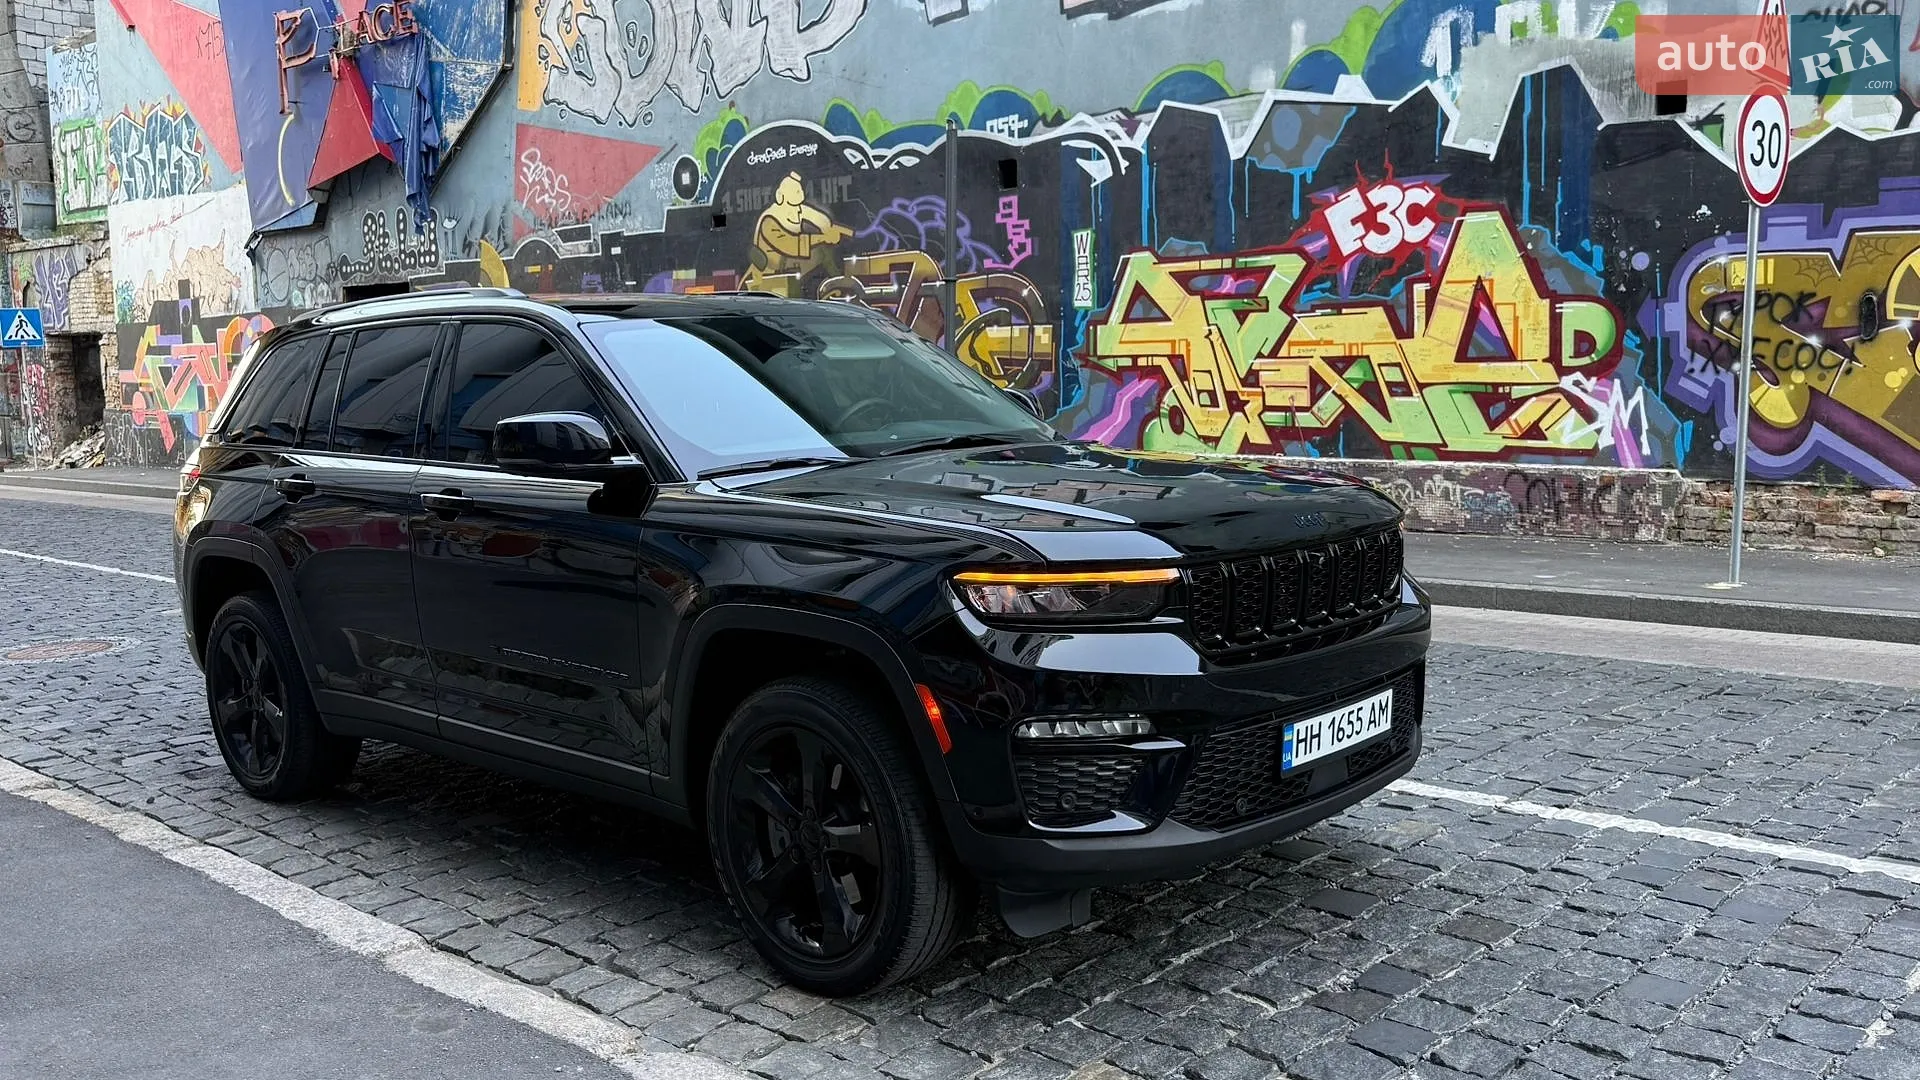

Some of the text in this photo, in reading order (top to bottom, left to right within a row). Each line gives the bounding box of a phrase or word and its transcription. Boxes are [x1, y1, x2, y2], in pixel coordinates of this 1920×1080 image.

[1749, 119, 1782, 169] 30
[1324, 184, 1437, 257] E3C
[1295, 695, 1390, 759] HH 1655 AM
